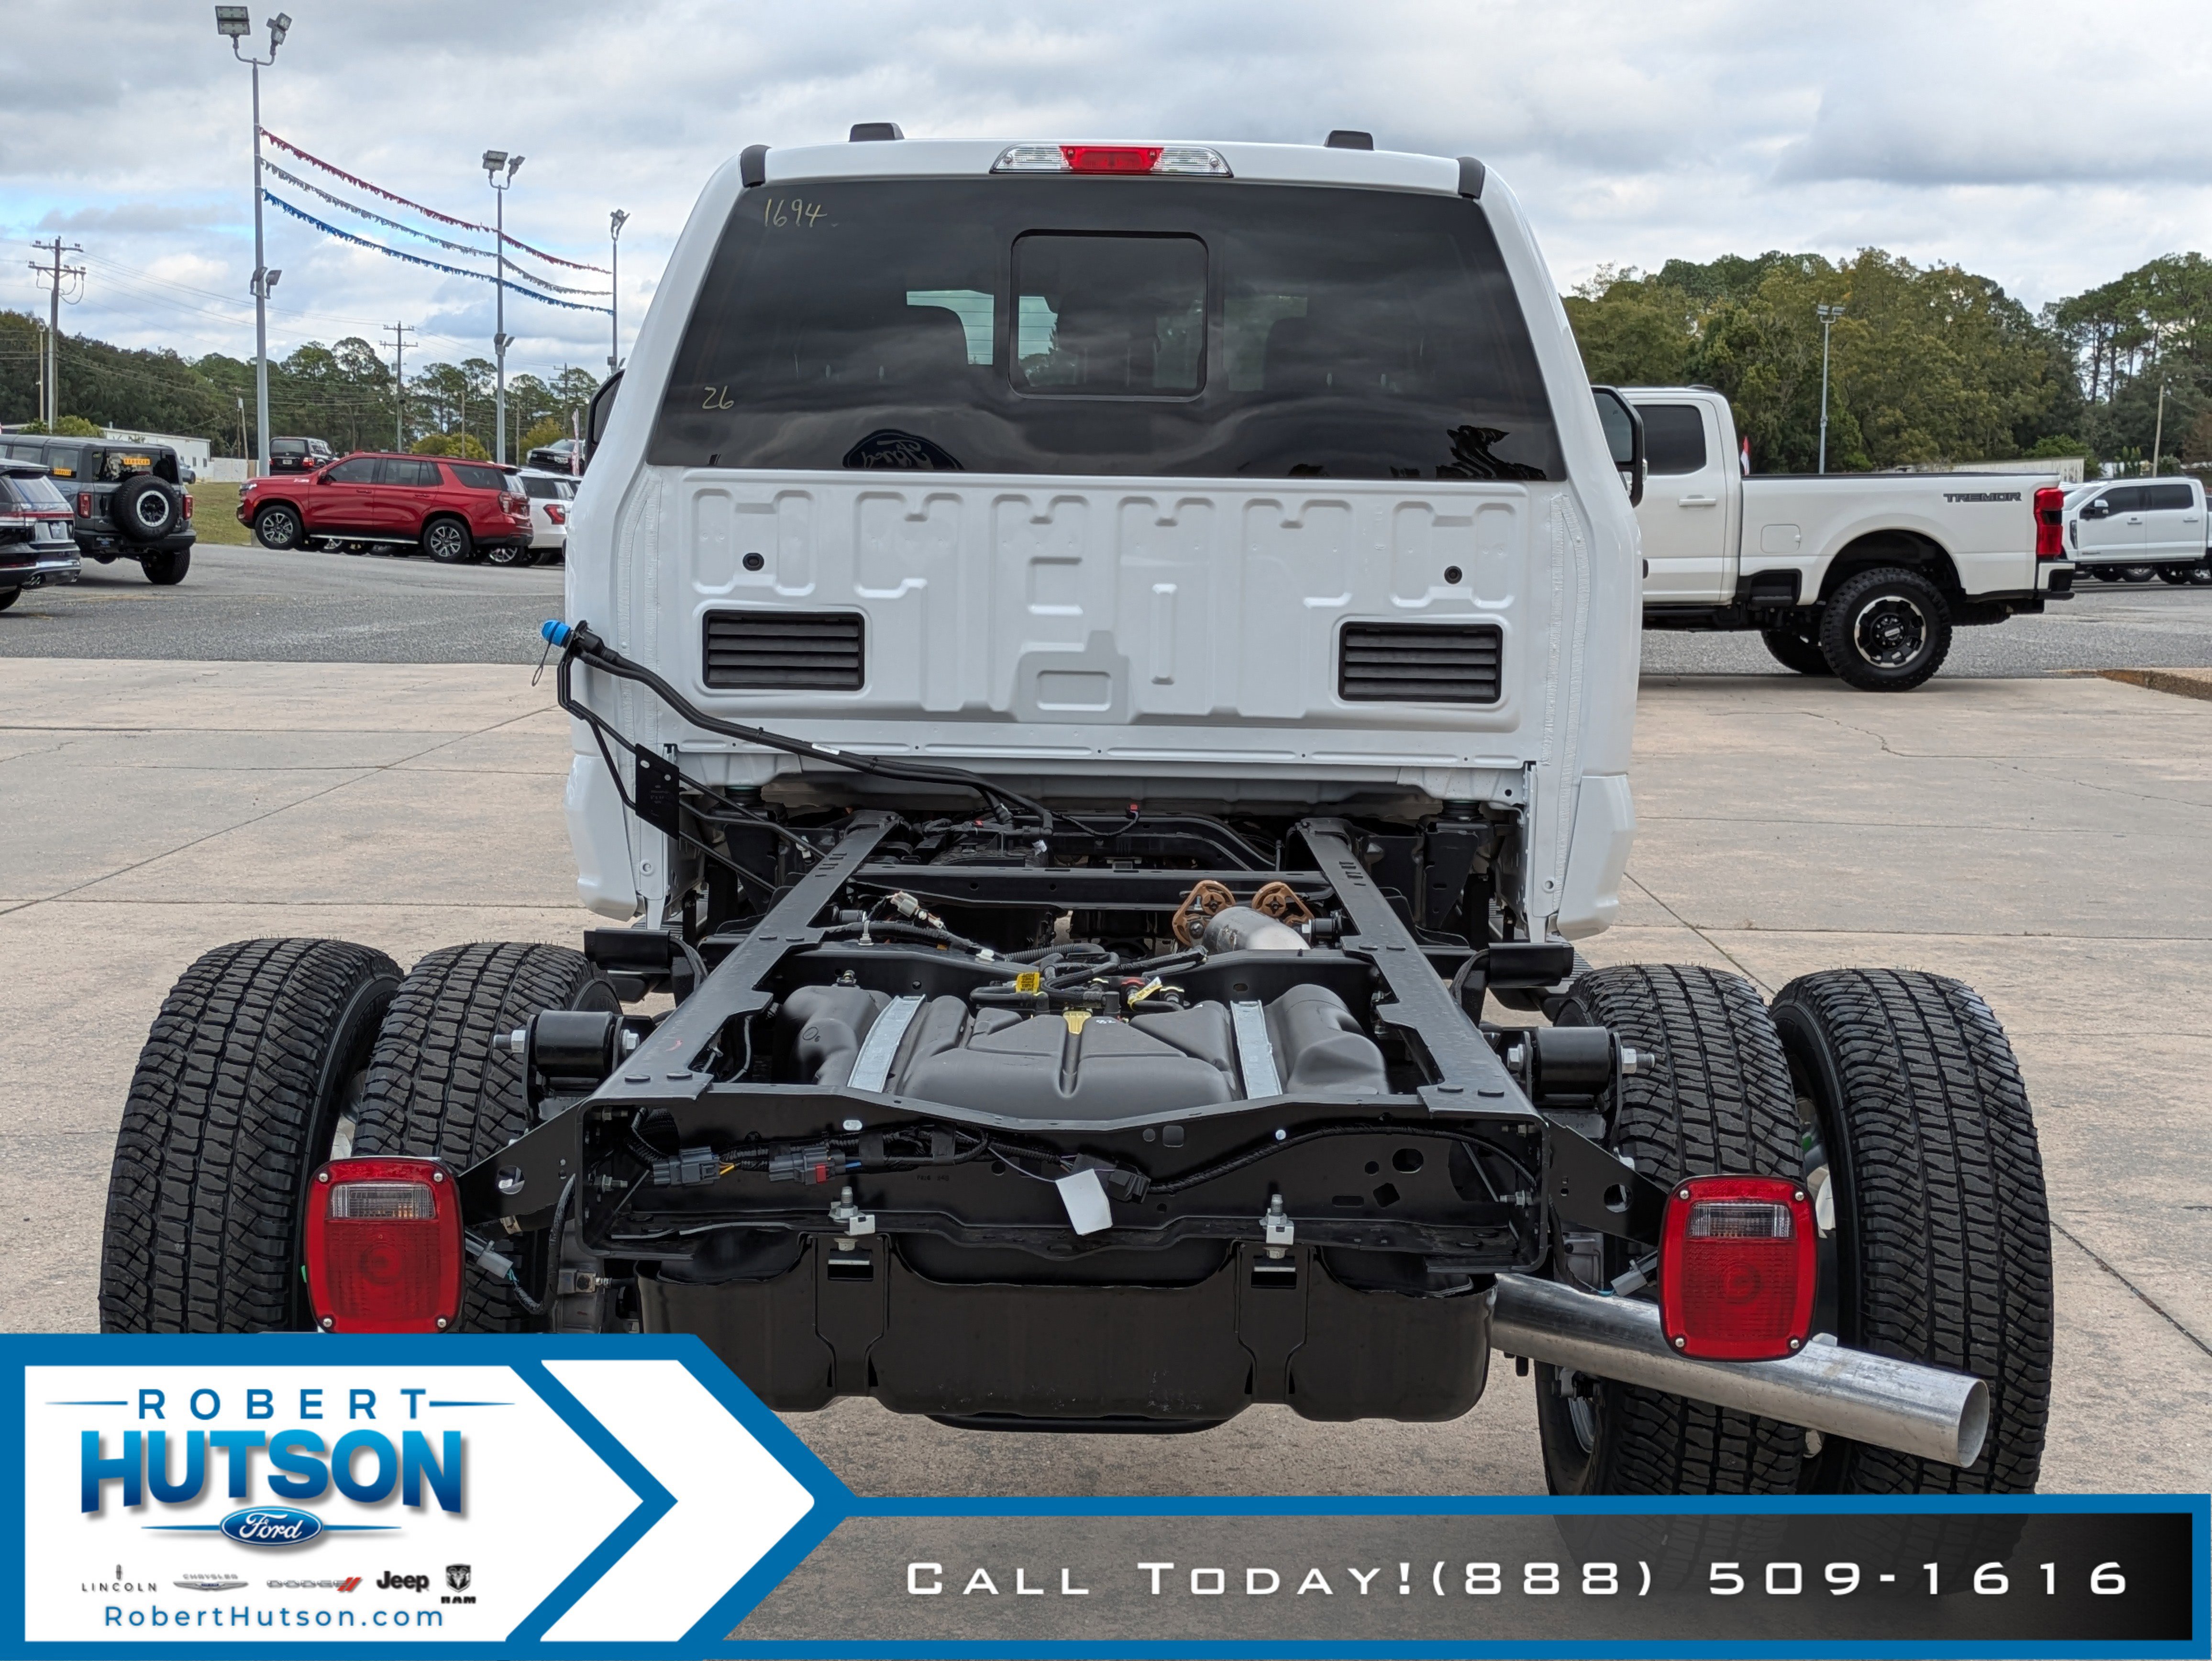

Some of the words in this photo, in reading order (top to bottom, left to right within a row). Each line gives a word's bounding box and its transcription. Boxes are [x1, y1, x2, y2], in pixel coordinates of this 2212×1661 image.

[764, 198, 828, 228] 1694
[702, 385, 735, 410] 26
[1943, 492, 2022, 503] TREMOR
